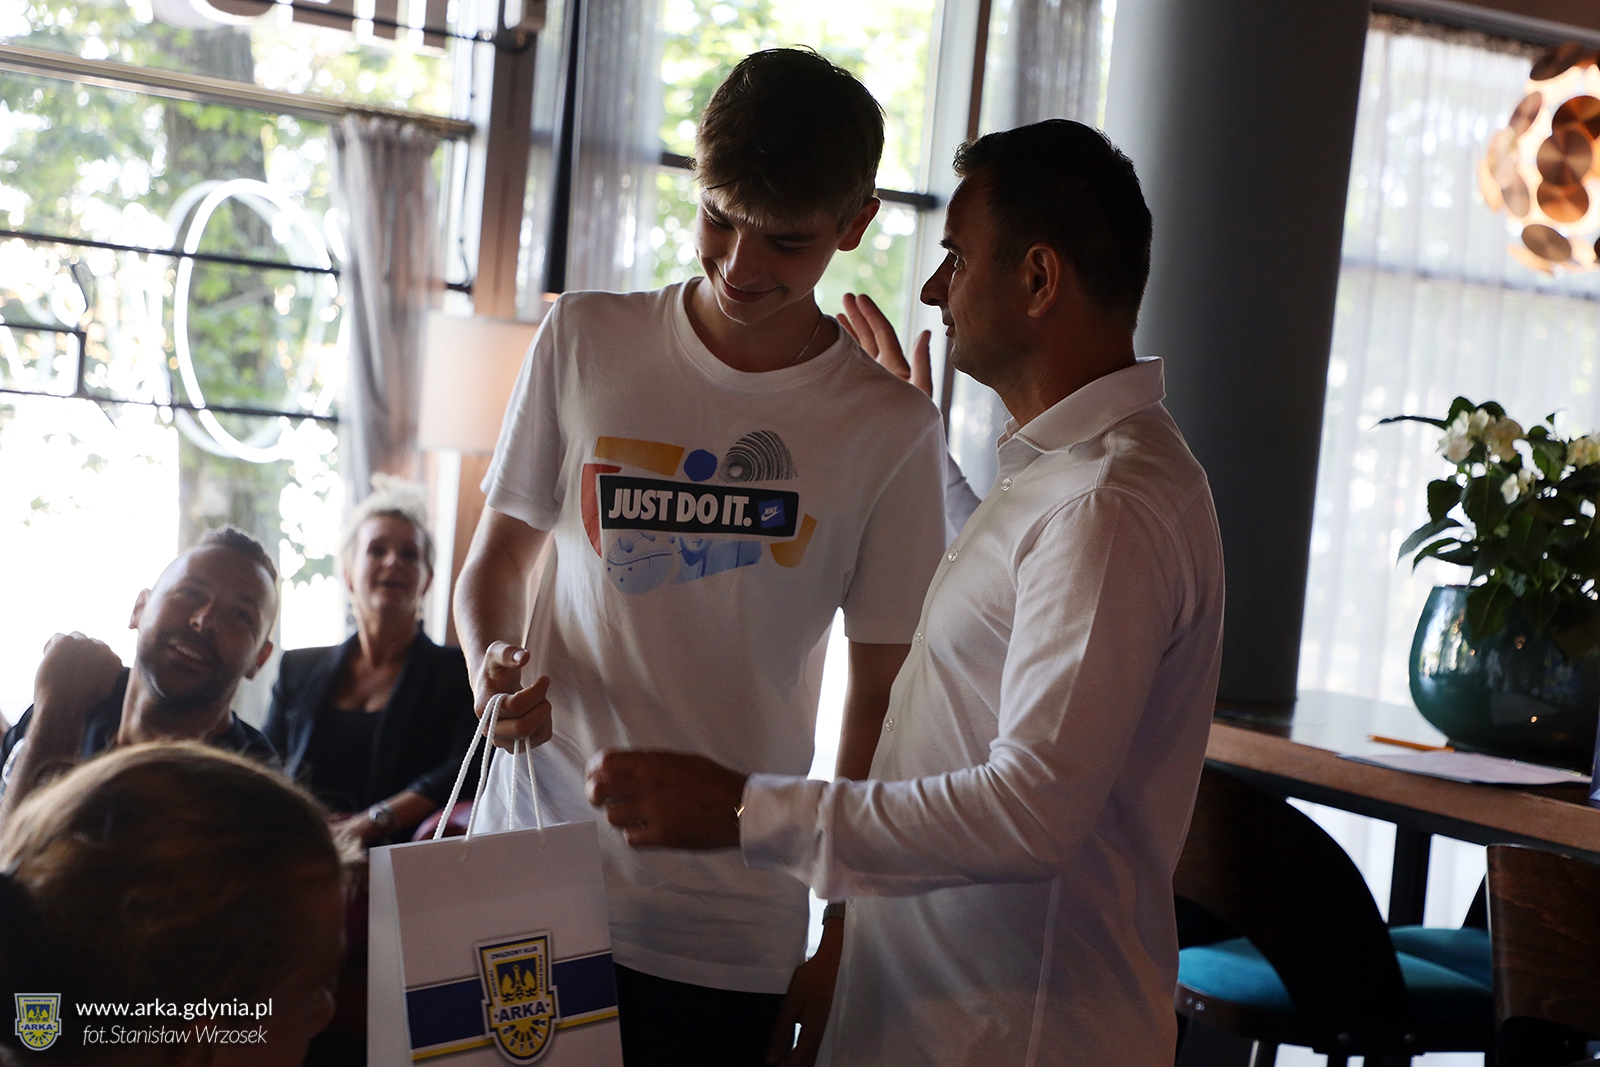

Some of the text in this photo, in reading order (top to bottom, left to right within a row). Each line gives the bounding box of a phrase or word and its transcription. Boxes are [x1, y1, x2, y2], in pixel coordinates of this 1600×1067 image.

[608, 488, 753, 527] JUST DO IT.
[499, 1001, 546, 1023] ARKA
